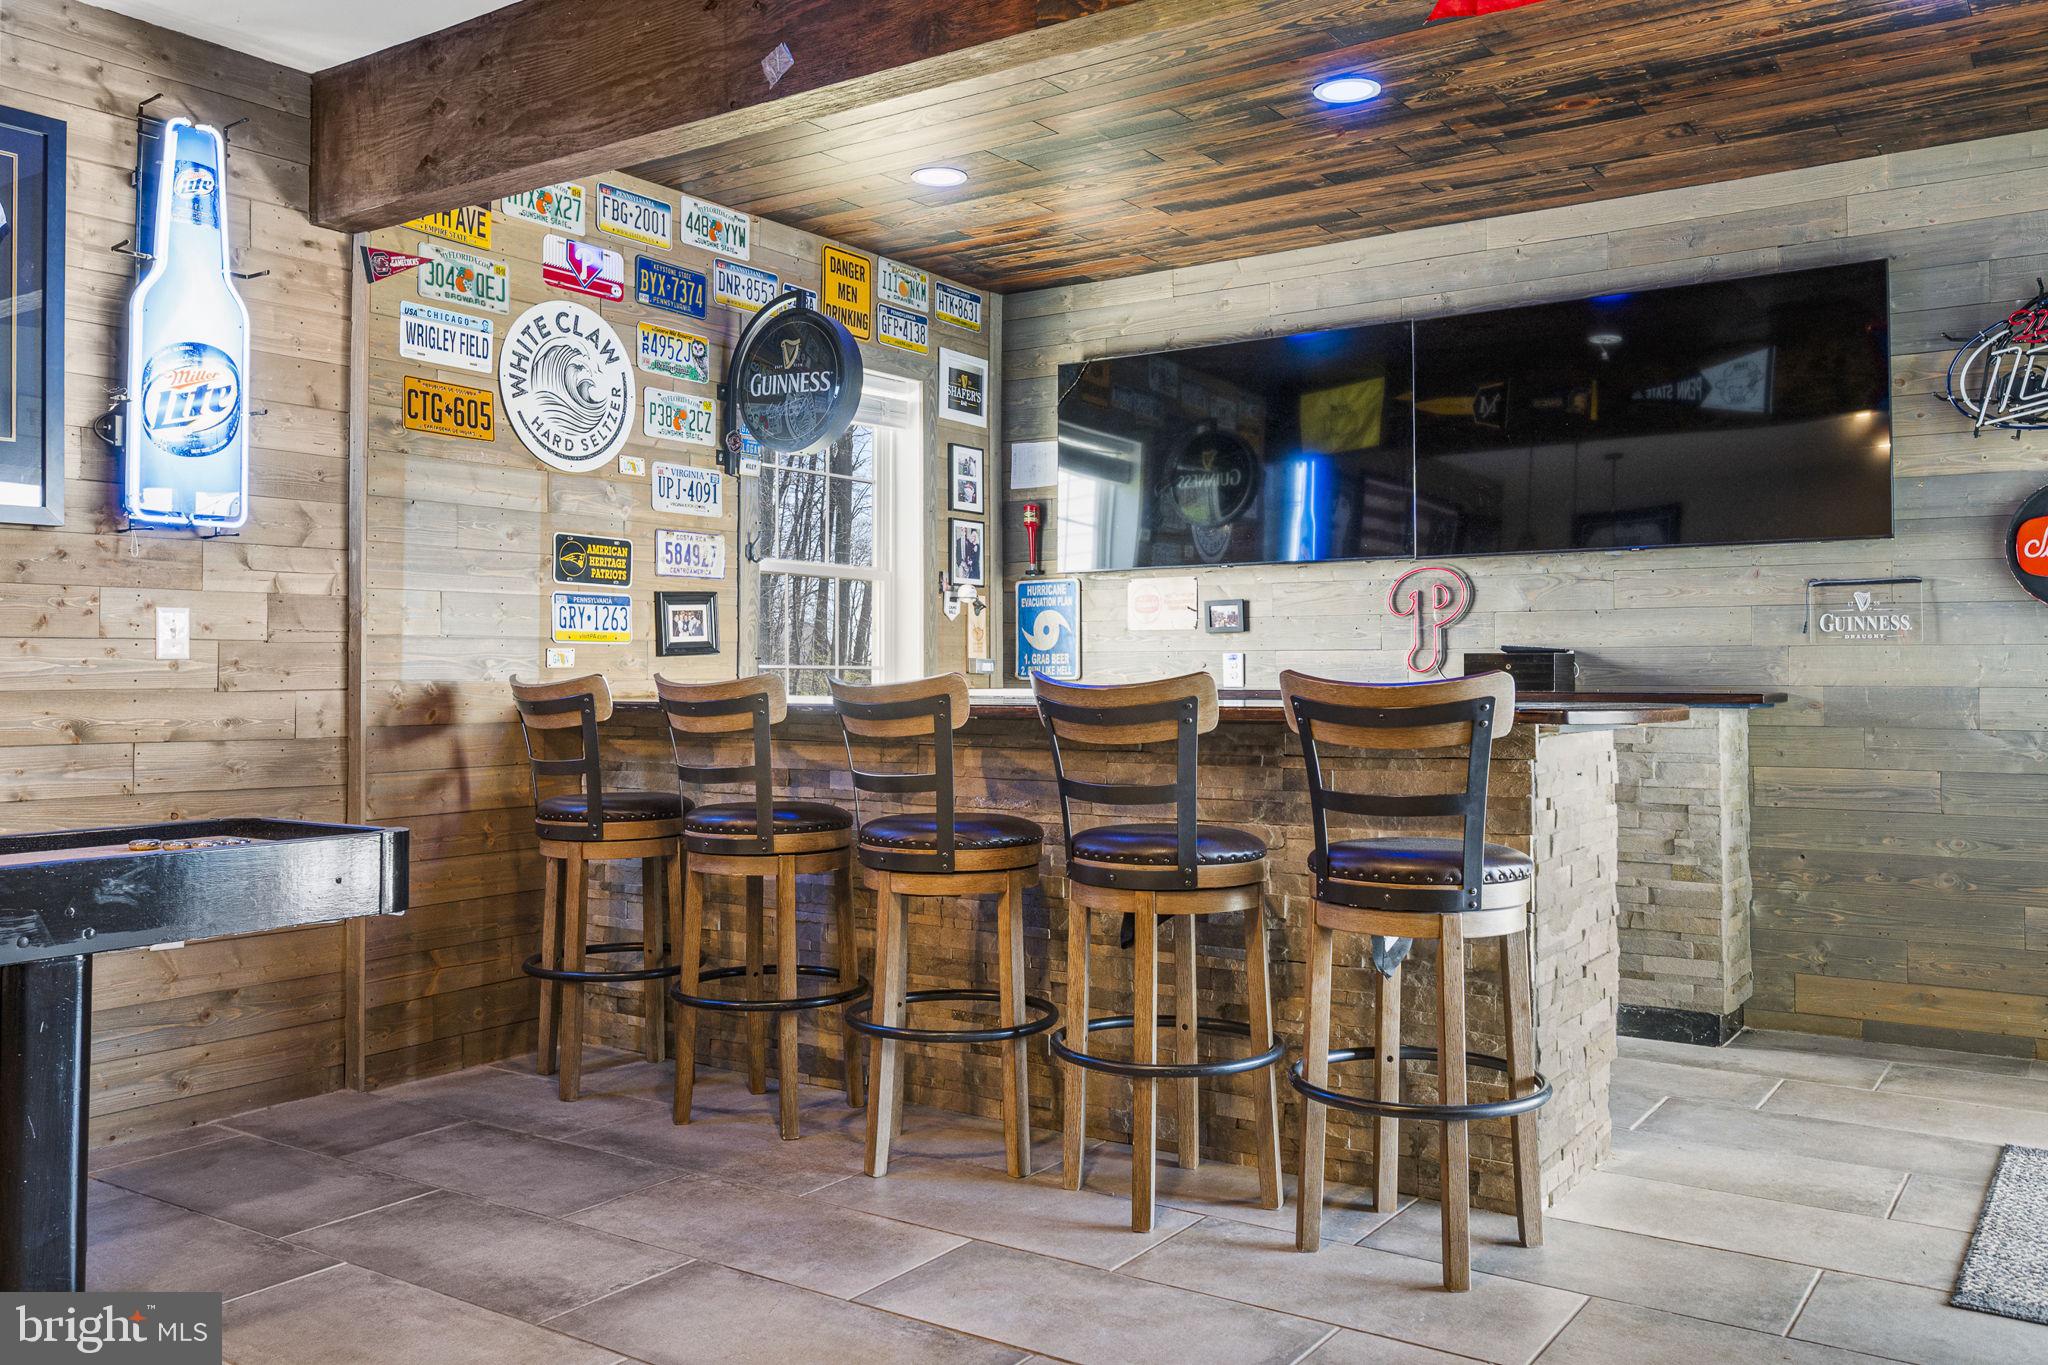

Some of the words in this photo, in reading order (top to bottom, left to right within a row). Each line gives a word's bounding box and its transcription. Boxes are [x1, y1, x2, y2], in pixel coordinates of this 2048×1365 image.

[555, 193, 581, 222] X27
[456, 207, 487, 238] AVE
[521, 209, 549, 223] SUNSHINE
[551, 217, 568, 228] STATE
[686, 212, 708, 238] 448
[424, 224, 447, 236] EMPIRE
[449, 230, 467, 242] STATE
[424, 261, 455, 290] 304
[653, 264, 677, 276] KEYSTONE
[678, 271, 692, 281] STATE
[830, 256, 866, 282] DANGER
[445, 292, 486, 307] BROWARD
[837, 282, 858, 303] MEN
[653, 296, 691, 311] PENNSYLVANIA
[404, 307, 418, 317] USA
[427, 309, 470, 326] CHICAGO
[825, 303, 868, 331] DRINKING
[405, 321, 457, 353] WRIGLEY
[460, 333, 490, 360] FIELD
[651, 333, 691, 362] 4952J
[509, 315, 552, 399] WHITE
[555, 311, 621, 365] CLAW
[167, 369, 218, 385] Miller
[750, 371, 831, 397] GUINNESS
[946, 385, 982, 404] SHAFER'S
[152, 383, 232, 430] Lite
[407, 389, 443, 423] CTG
[454, 397, 491, 430] 605
[531, 416, 574, 451] HARD
[581, 387, 621, 451] SELTZER
[650, 402, 672, 428] P38
[689, 410, 711, 434] 2CZ
[661, 428, 683, 438] SUNSHINE
[671, 468, 704, 480] VIRGINIA
[658, 475, 718, 505] UPJ-4091
[676, 533, 693, 541] COSTA
[587, 544, 628, 558] AMERICAN
[589, 556, 627, 569] HERITAGE
[670, 567, 712, 575] CENTROAMERICA
[591, 568, 627, 580] PATRIOTS
[1026, 584, 1067, 596] HURRICANE
[573, 596, 613, 604] PENNSYLVANIA
[1021, 597, 1057, 608] EVACUATION
[1057, 596, 1073, 607] PLAN
[1819, 613, 1911, 632] GUINNESS
[1024, 654, 1030, 664] 1.
[1031, 653, 1050, 665] GRAB
[1051, 653, 1070, 664] BEER
[1041, 666, 1056, 675] LIKE
[1057, 666, 1072, 675] HELL
